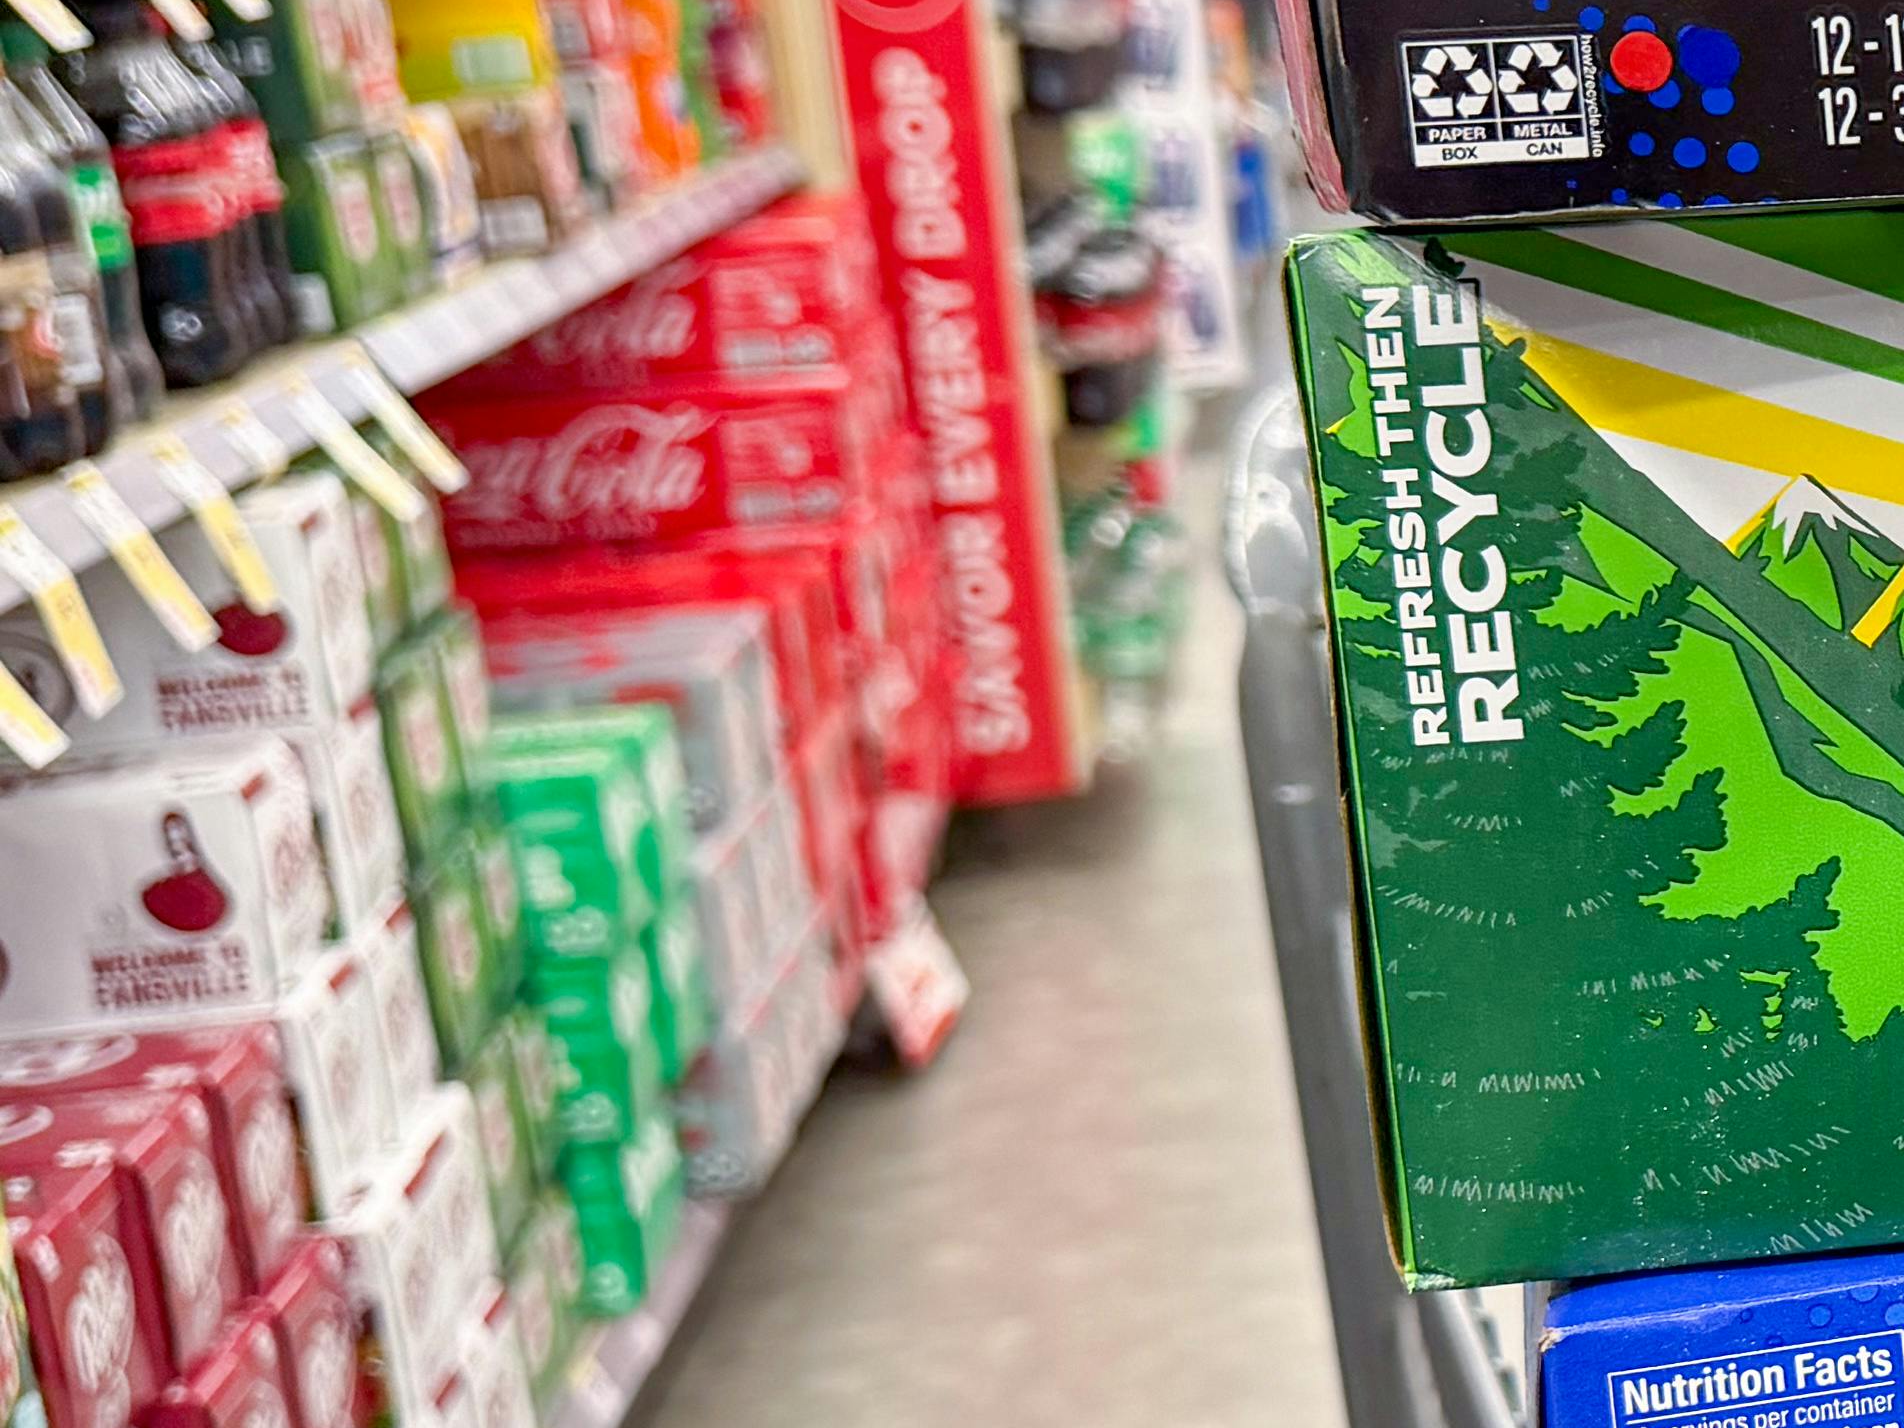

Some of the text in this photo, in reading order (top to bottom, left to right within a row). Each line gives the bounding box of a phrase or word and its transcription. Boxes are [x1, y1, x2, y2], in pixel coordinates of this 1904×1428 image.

[1811, 14, 1855, 75] 12
[1428, 126, 1486, 142] PAPER
[1513, 122, 1572, 138] METAL
[1818, 86, 1861, 146] 12
[1442, 145, 1478, 161] BOX
[1526, 142, 1562, 157] CAN
[1362, 285, 1450, 746] REFRESH THEN
[1412, 284, 1525, 743] RECYCLE
[1623, 1346, 1893, 1415] Nutrition Facts
